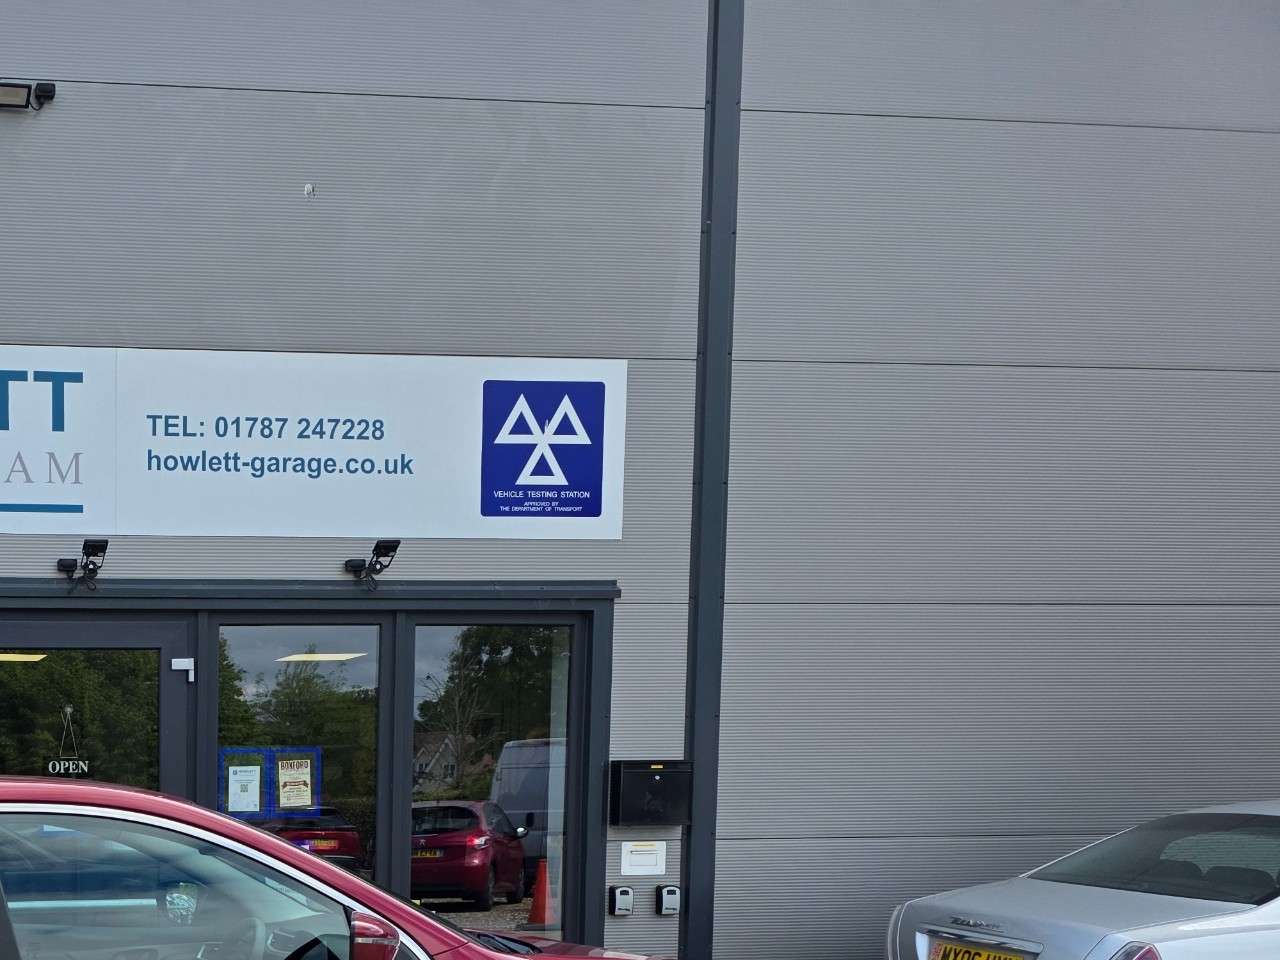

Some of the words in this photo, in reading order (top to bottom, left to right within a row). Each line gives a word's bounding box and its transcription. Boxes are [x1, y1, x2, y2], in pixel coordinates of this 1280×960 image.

[147, 415, 205, 437] TEL:
[215, 417, 288, 438] 01787
[297, 418, 384, 440] 247228
[148, 449, 413, 479] howlett-garage.co.uk
[48, 760, 89, 773] OPEN
